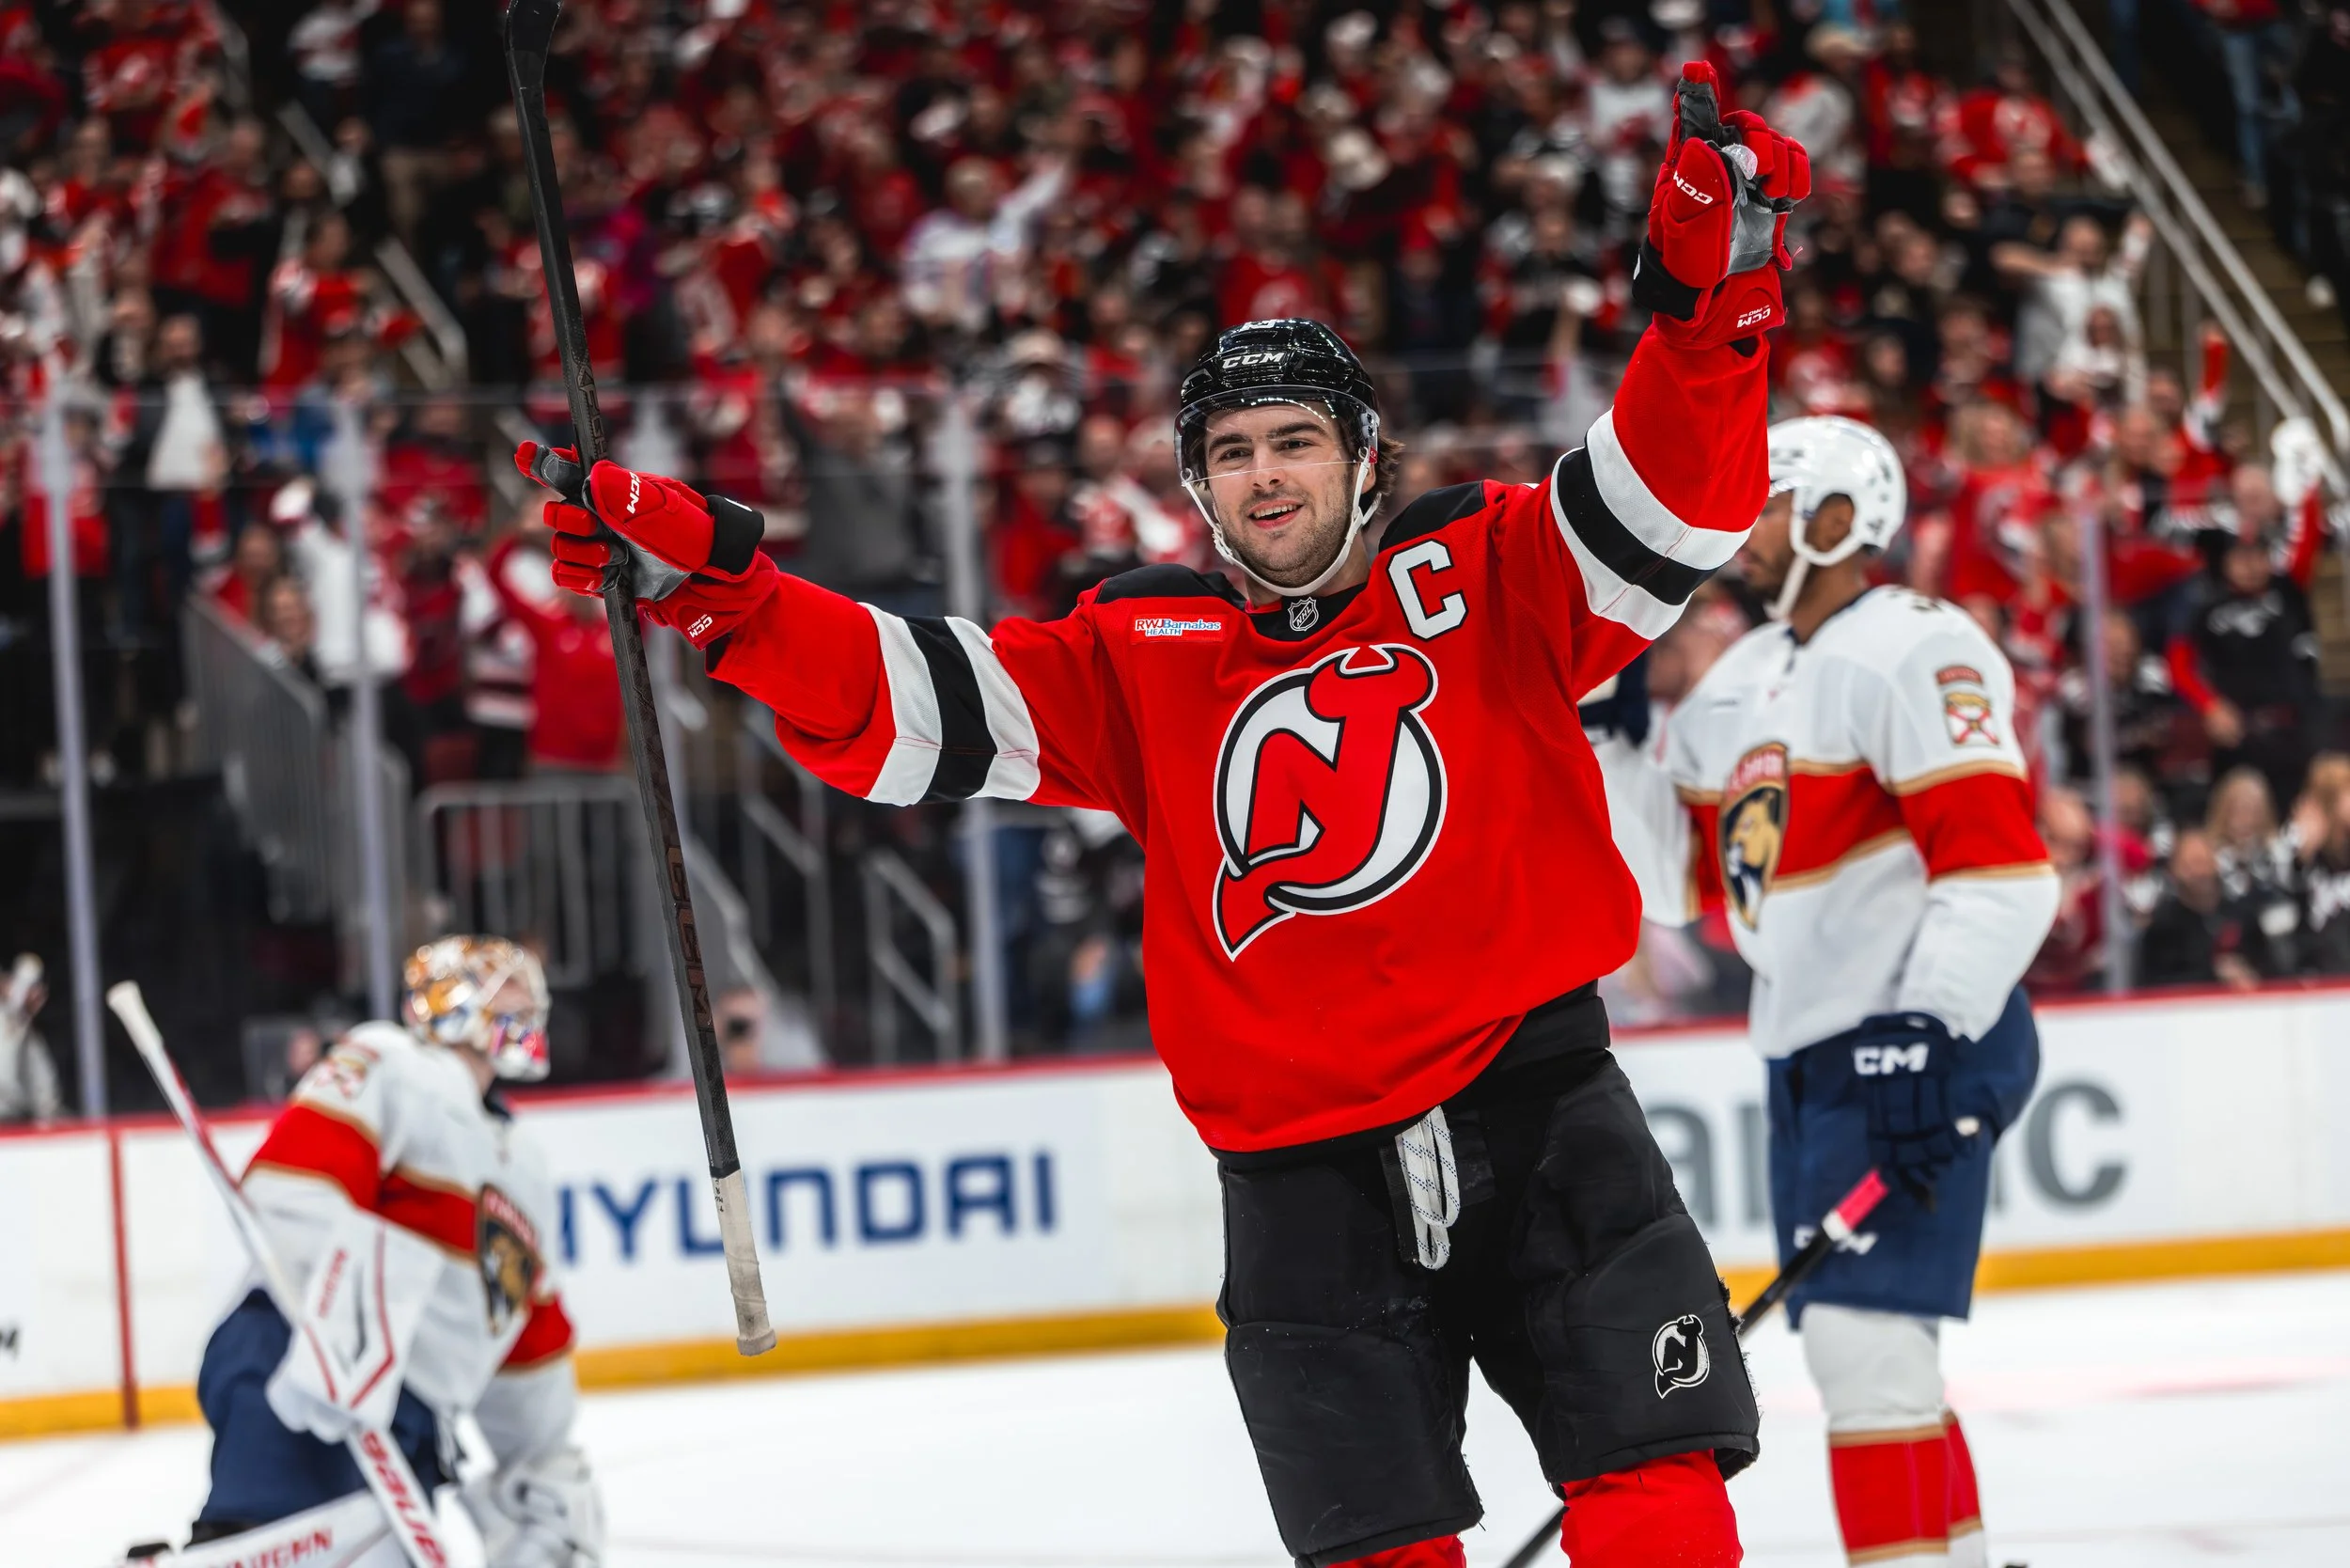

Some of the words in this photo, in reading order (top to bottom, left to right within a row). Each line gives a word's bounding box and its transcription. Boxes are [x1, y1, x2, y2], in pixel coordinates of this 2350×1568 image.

[1672, 170, 1714, 205] CCM
[1737, 306, 1771, 328] CCM
[1222, 353, 1285, 368] CCM
[1386, 539, 1468, 642] C
[689, 616, 713, 638] CCM
[1296, 606, 1312, 627] NHL
